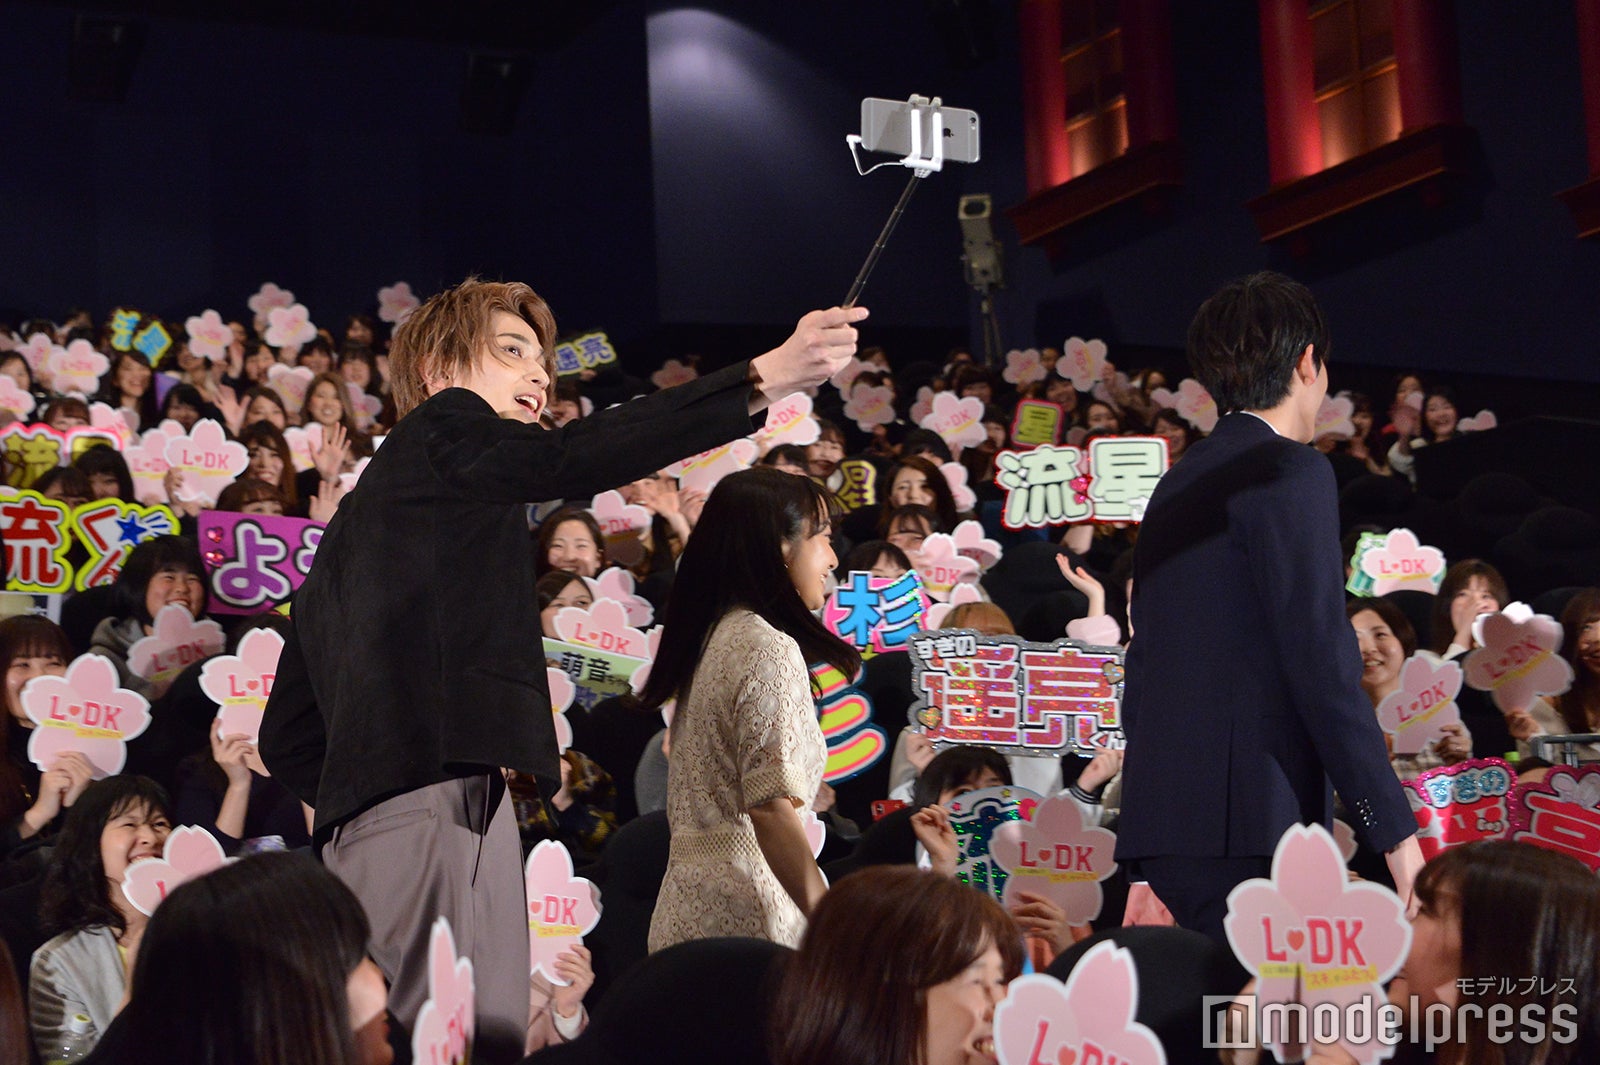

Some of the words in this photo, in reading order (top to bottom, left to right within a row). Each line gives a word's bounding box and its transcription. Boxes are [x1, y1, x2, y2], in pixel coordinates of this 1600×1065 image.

[997, 440, 1166, 526] 流星
[836, 572, 922, 648] 杉
[914, 634, 979, 661] すぎの
